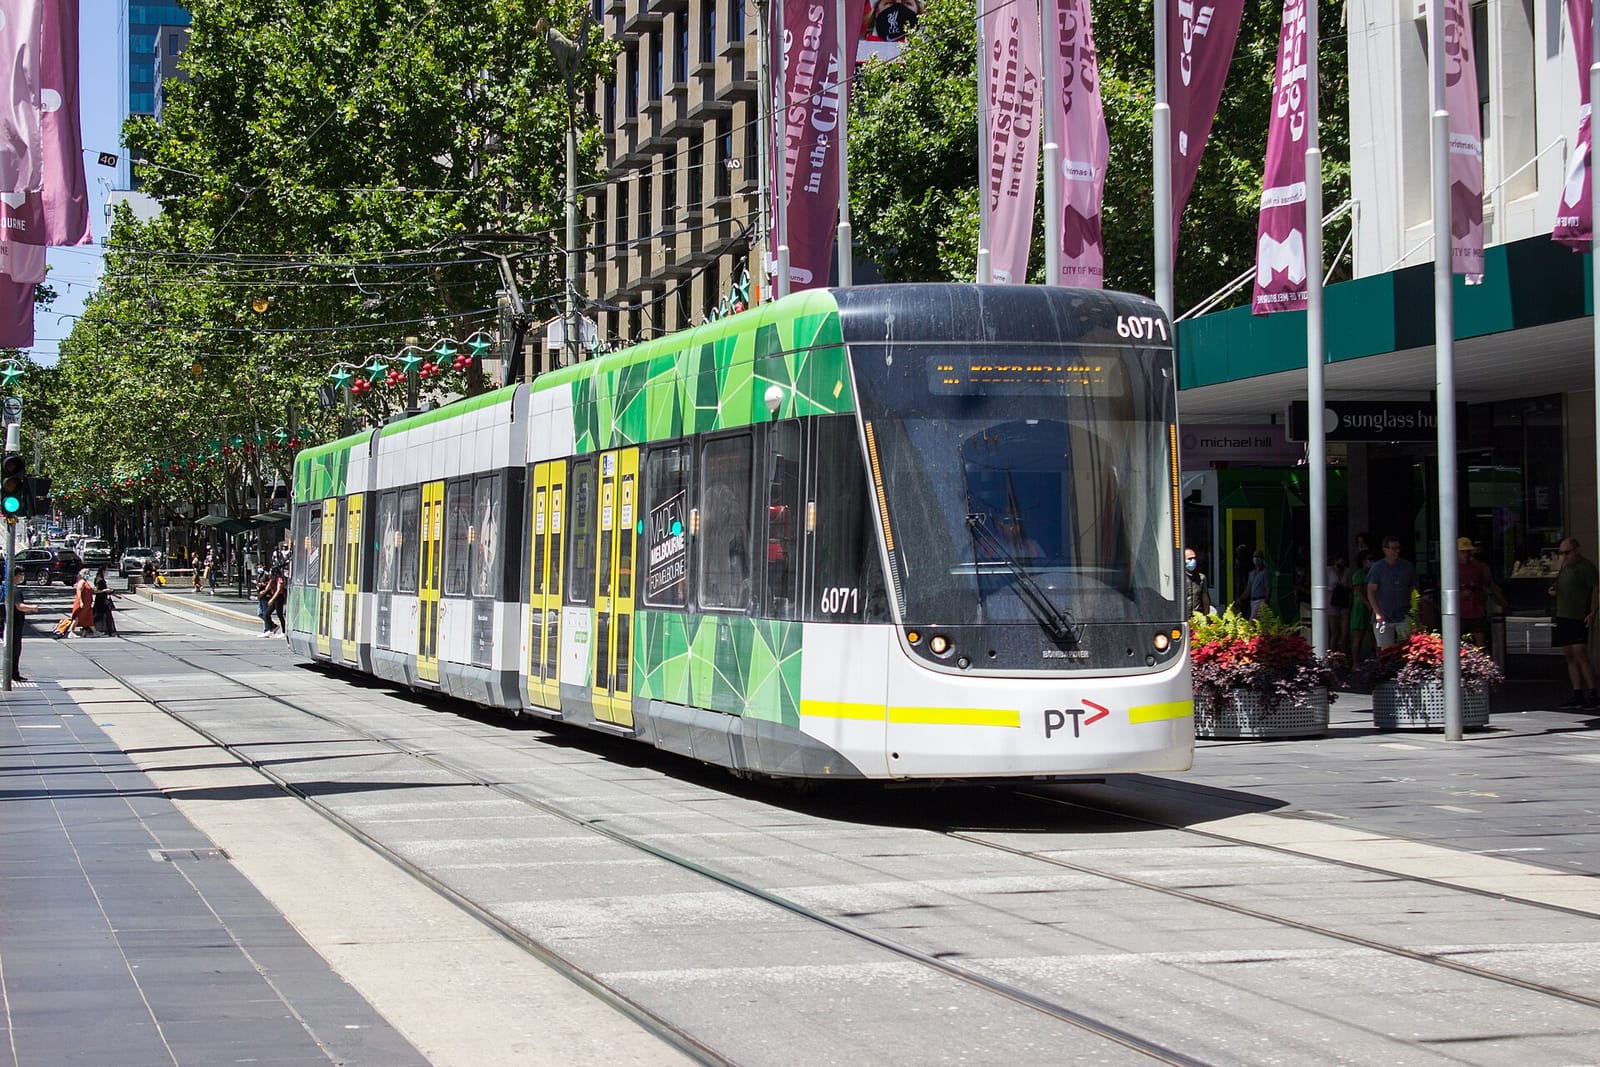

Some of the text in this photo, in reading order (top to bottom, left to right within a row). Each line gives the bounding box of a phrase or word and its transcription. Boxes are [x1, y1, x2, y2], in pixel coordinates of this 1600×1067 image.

[100, 155, 116, 166] 40
[727, 159, 740, 168] 40
[1011, 140, 1025, 176] the
[803, 172, 821, 194] in
[1007, 178, 1020, 198] in
[1117, 315, 1167, 341] 6071
[1343, 409, 1414, 433] sunglass
[1199, 436, 1273, 448] michael hill
[821, 587, 858, 614] 6071
